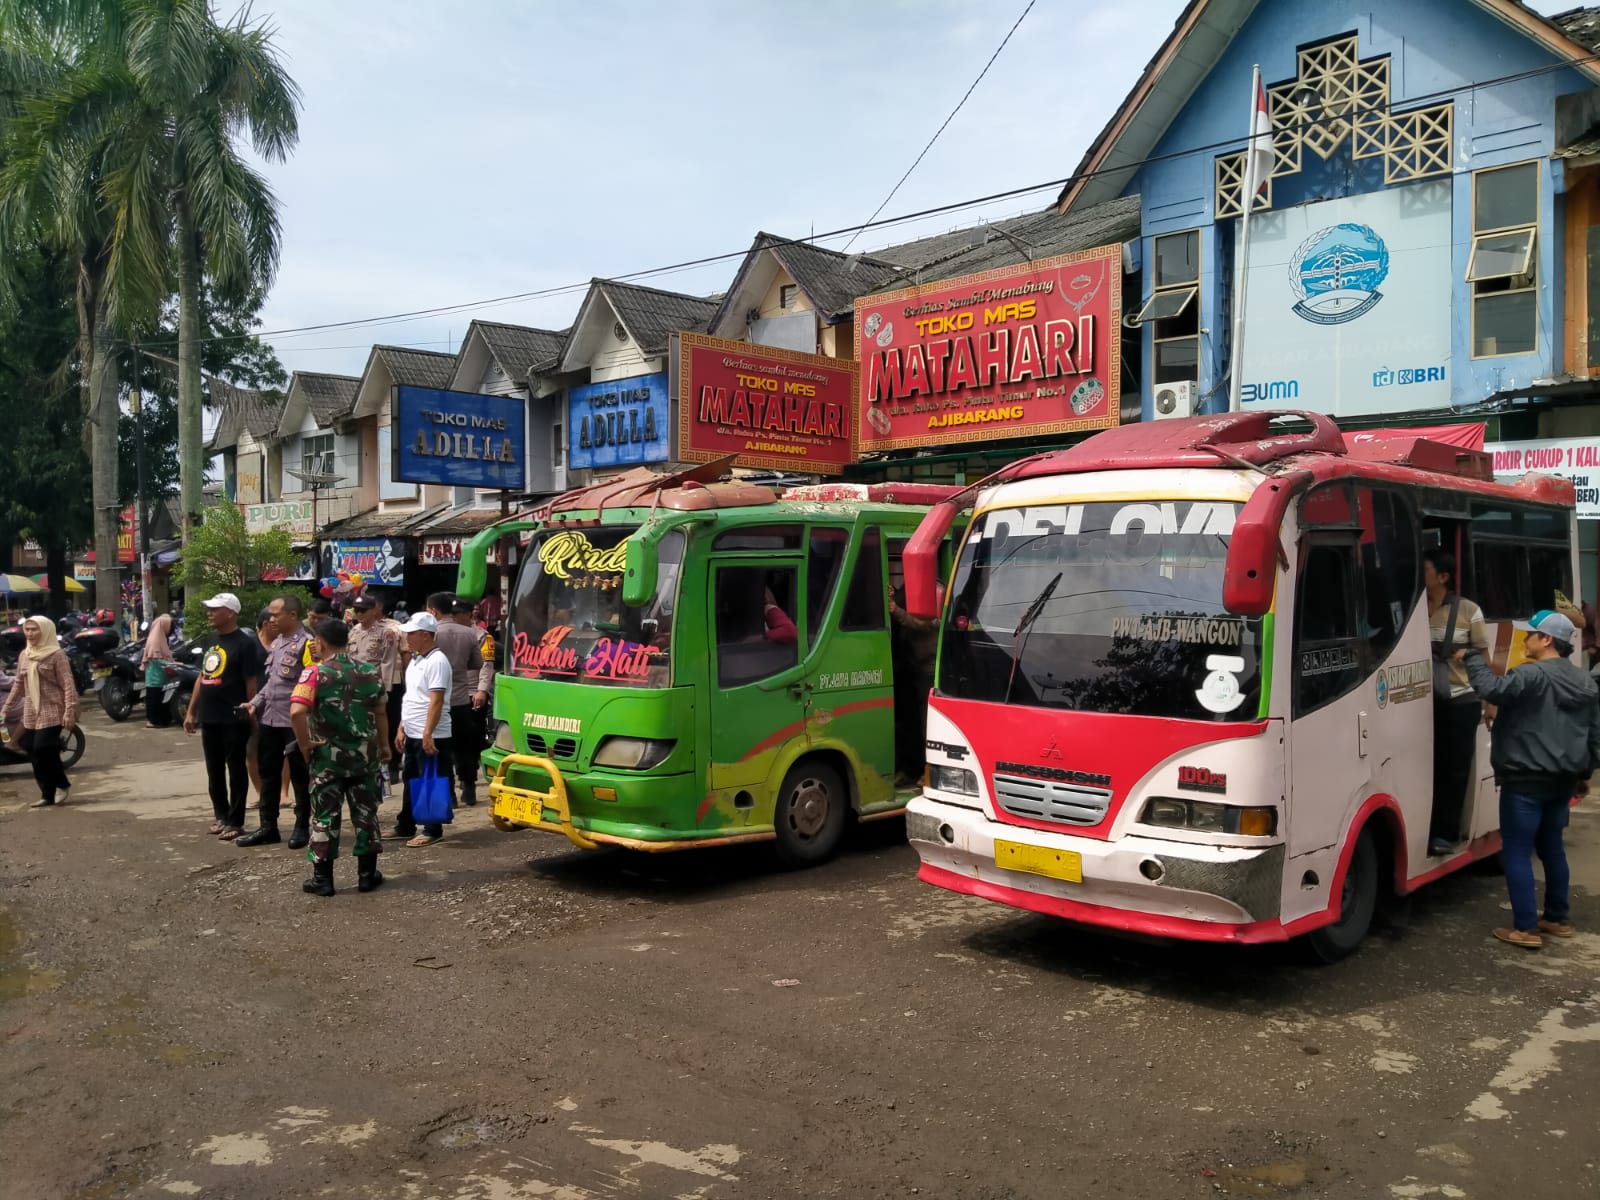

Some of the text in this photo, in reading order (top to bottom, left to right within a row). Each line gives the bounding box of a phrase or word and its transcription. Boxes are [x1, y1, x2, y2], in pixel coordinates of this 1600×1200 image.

[987, 280, 1054, 303] Menabung
[915, 300, 1036, 337] TOKO MAS
[868, 314, 1094, 402] MATAHARI
[736, 374, 816, 397] TOKO MAS
[1415, 366, 1445, 383] BRI
[588, 387, 650, 409] TOKO MAS
[422, 410, 507, 431] TOKO MAS
[700, 385, 849, 439] MATAHARI
[927, 405, 1024, 428] AJIBARANG
[580, 406, 658, 449] ADILLA
[412, 428, 515, 463] ADILLA
[745, 441, 807, 455] AJIBARANG
[1493, 450, 1521, 470] RKIR
[1524, 447, 1563, 469] CUKUP
[1567, 447, 1573, 467] 1
[1576, 488, 1599, 505] BER)
[248, 502, 312, 522] PURI
[586, 637, 660, 678] Hati
[547, 715, 581, 733] MANDIRI
